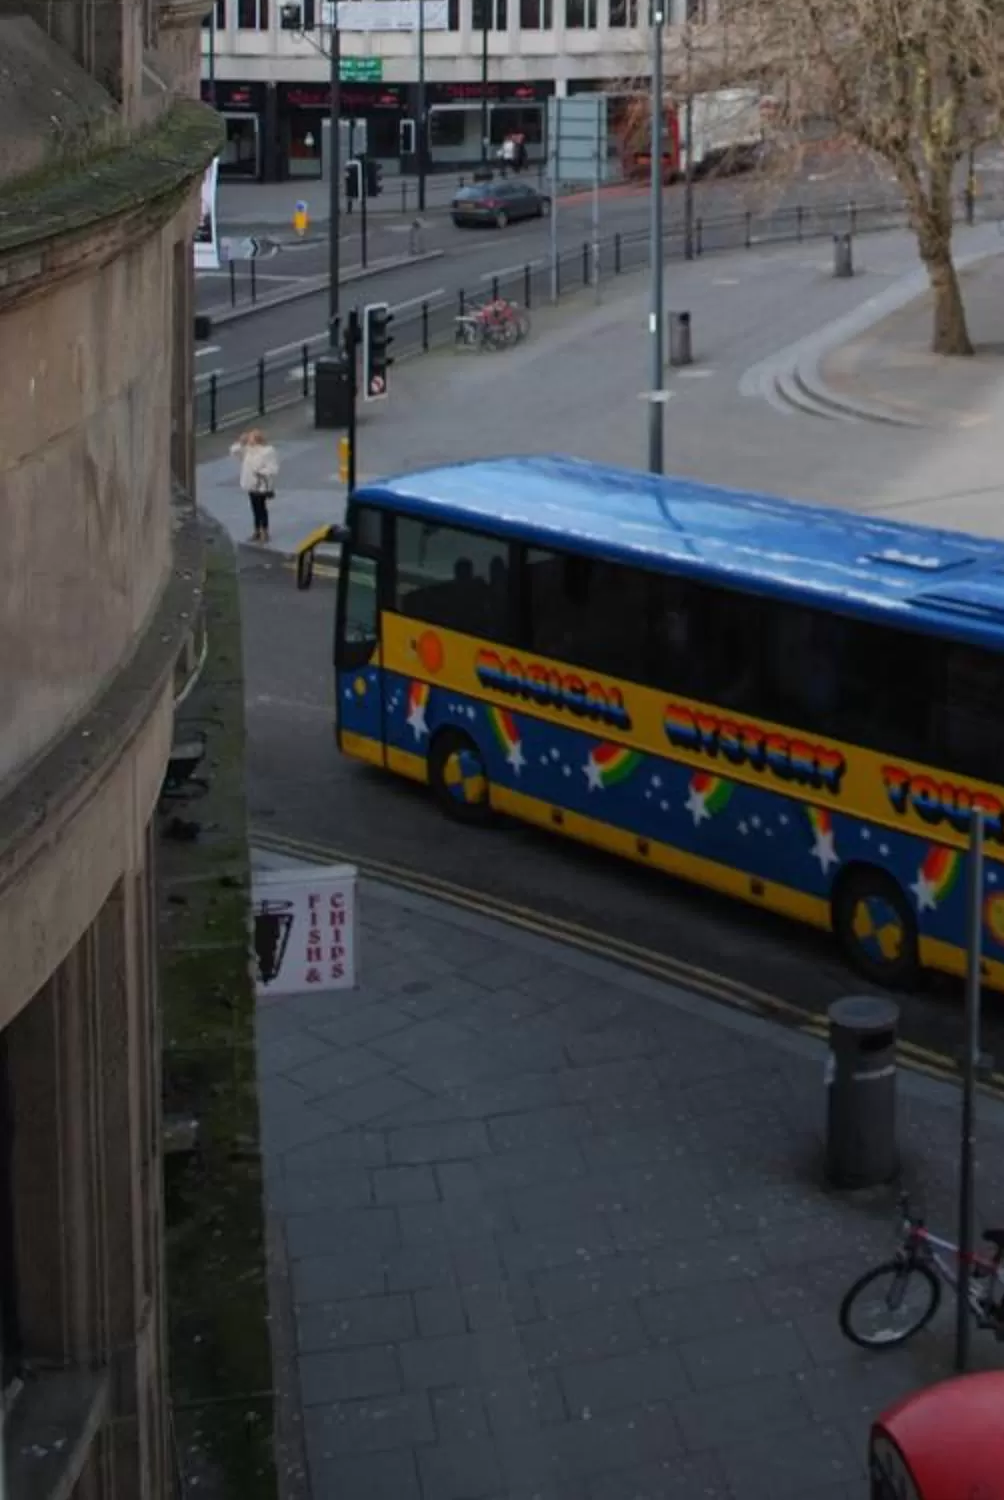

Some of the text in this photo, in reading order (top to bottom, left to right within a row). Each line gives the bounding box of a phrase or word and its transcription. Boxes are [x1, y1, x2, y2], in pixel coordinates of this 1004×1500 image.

[475, 647, 633, 731] MAGICAL
[663, 703, 847, 796] MYSTERY
[305, 893, 323, 963] FISH
[329, 891, 345, 979] CHIPS
